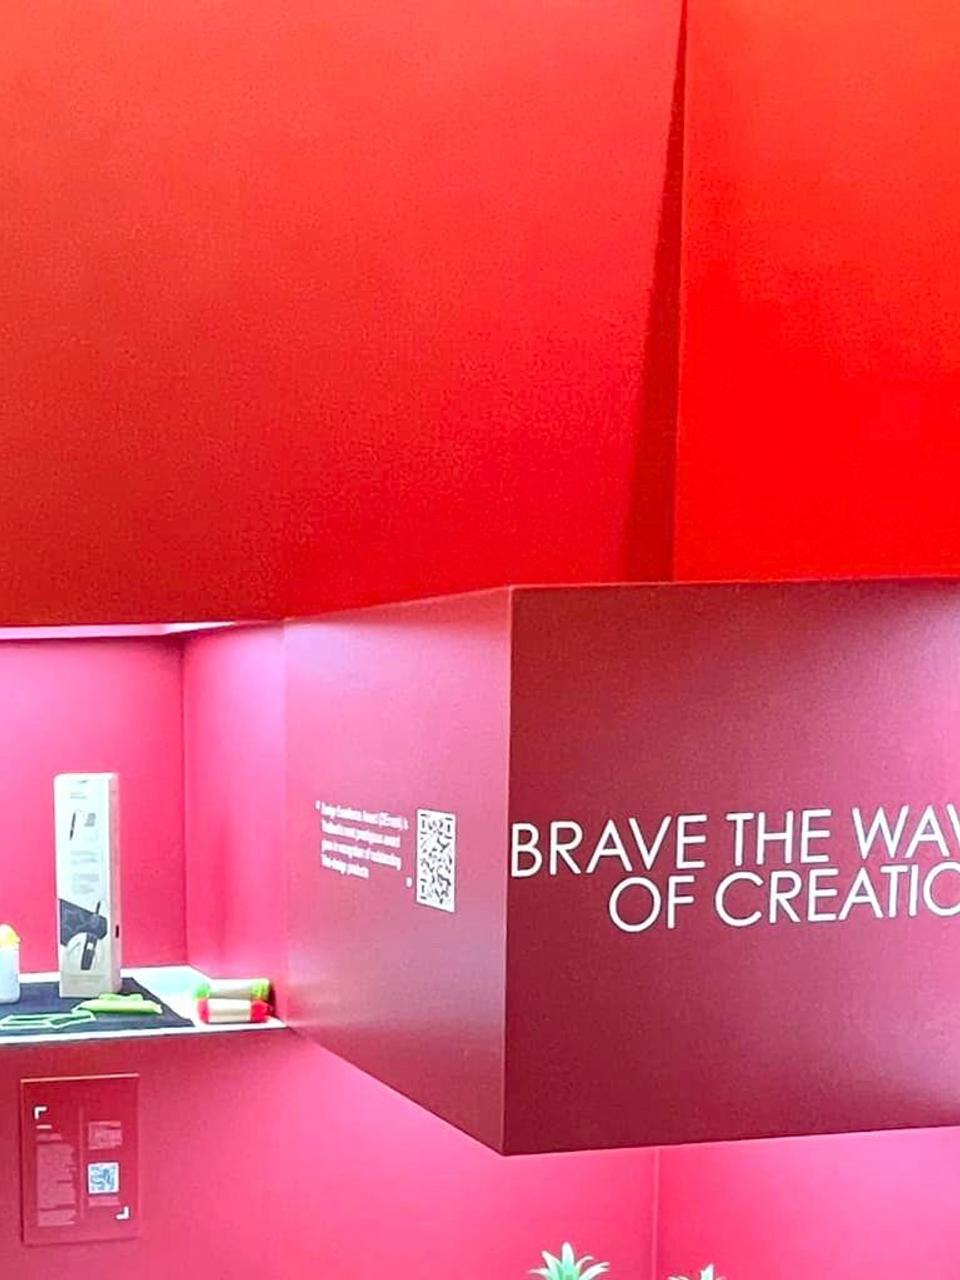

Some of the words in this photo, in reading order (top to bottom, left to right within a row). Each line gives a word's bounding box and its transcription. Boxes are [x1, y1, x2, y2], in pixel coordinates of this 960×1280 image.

[510, 813, 708, 878] BRAVE
[725, 808, 832, 866] THE
[608, 874, 696, 933] OF
